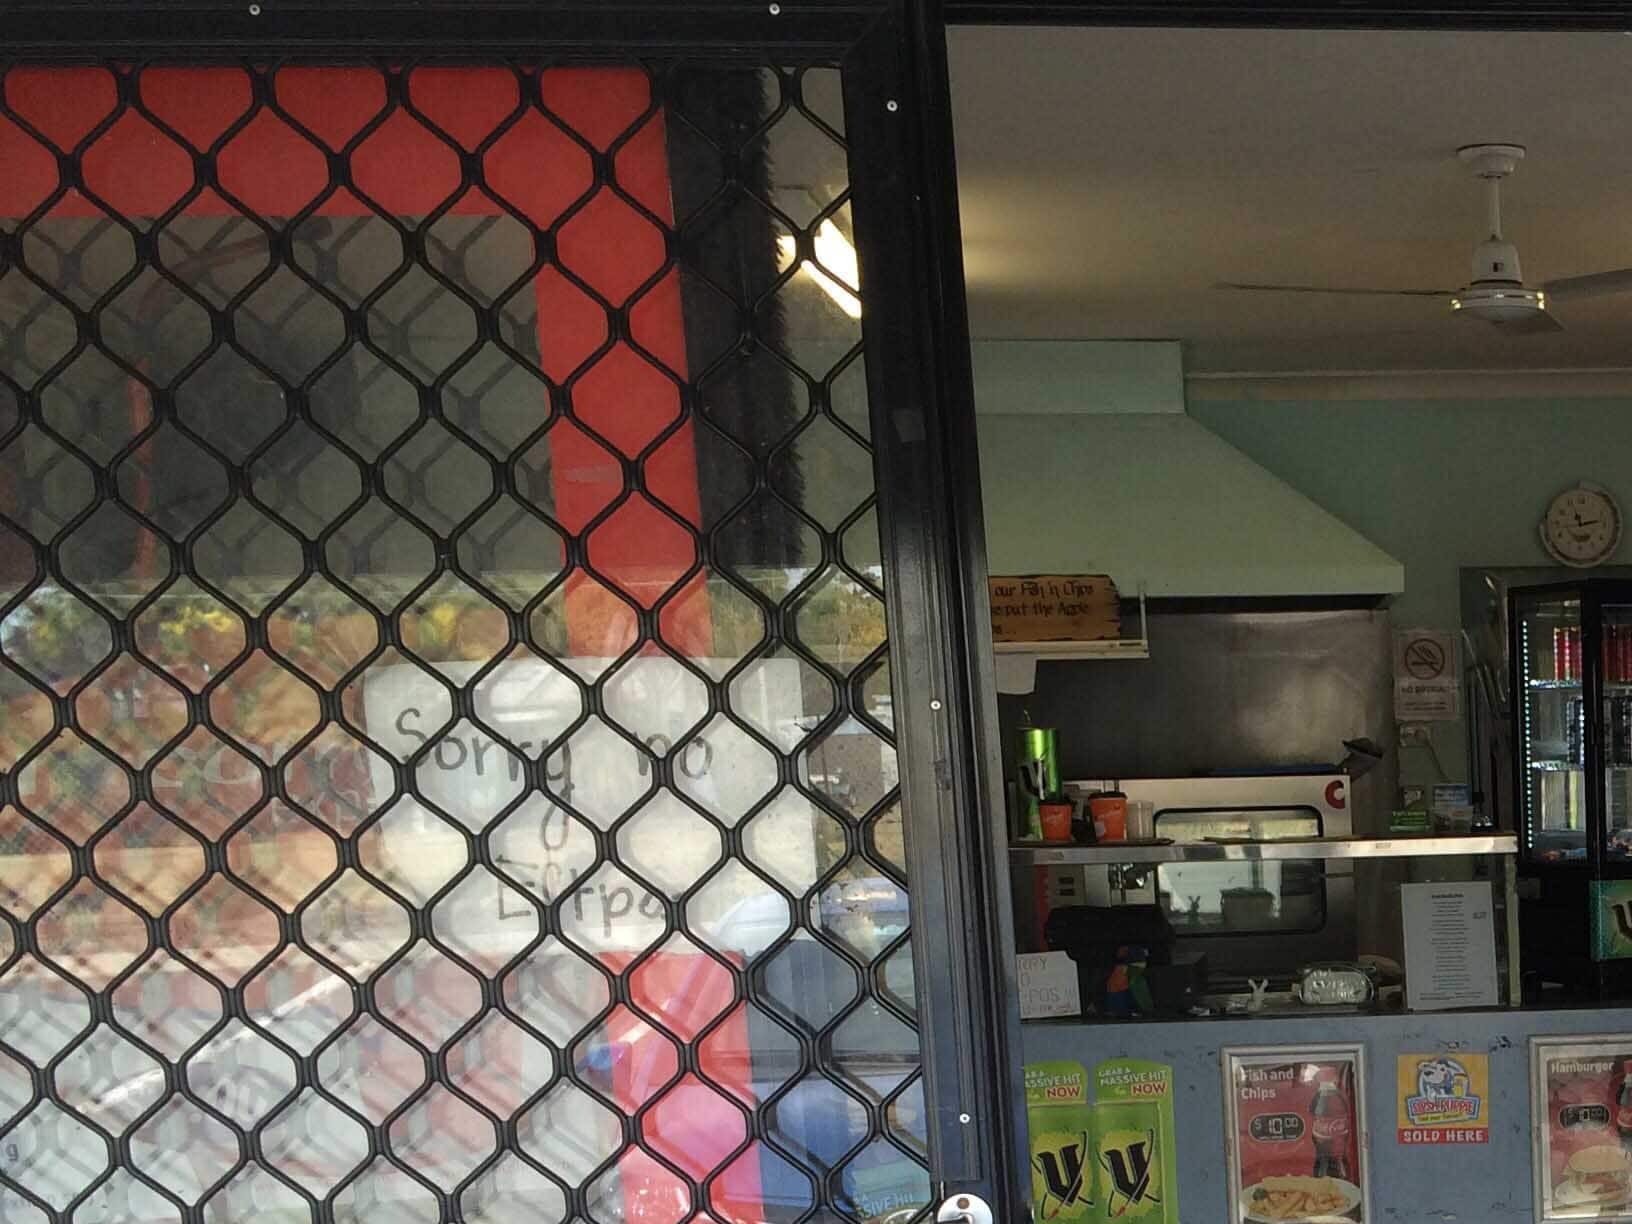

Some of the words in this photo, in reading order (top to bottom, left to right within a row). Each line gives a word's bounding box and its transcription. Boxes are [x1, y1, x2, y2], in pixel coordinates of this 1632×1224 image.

[1270, 1067, 1295, 1081] and
[1552, 1061, 1615, 1074] Hamburger
[1100, 1072, 1146, 1086] MASSIVE
[1148, 1069, 1168, 1081] HIT
[1047, 1086, 1080, 1098] NOW
[1132, 1082, 1166, 1095] NOW
[1241, 1087, 1277, 1101] Chips
[1404, 1130, 1441, 1142] SOLD
[1446, 1130, 1484, 1142] HERE
